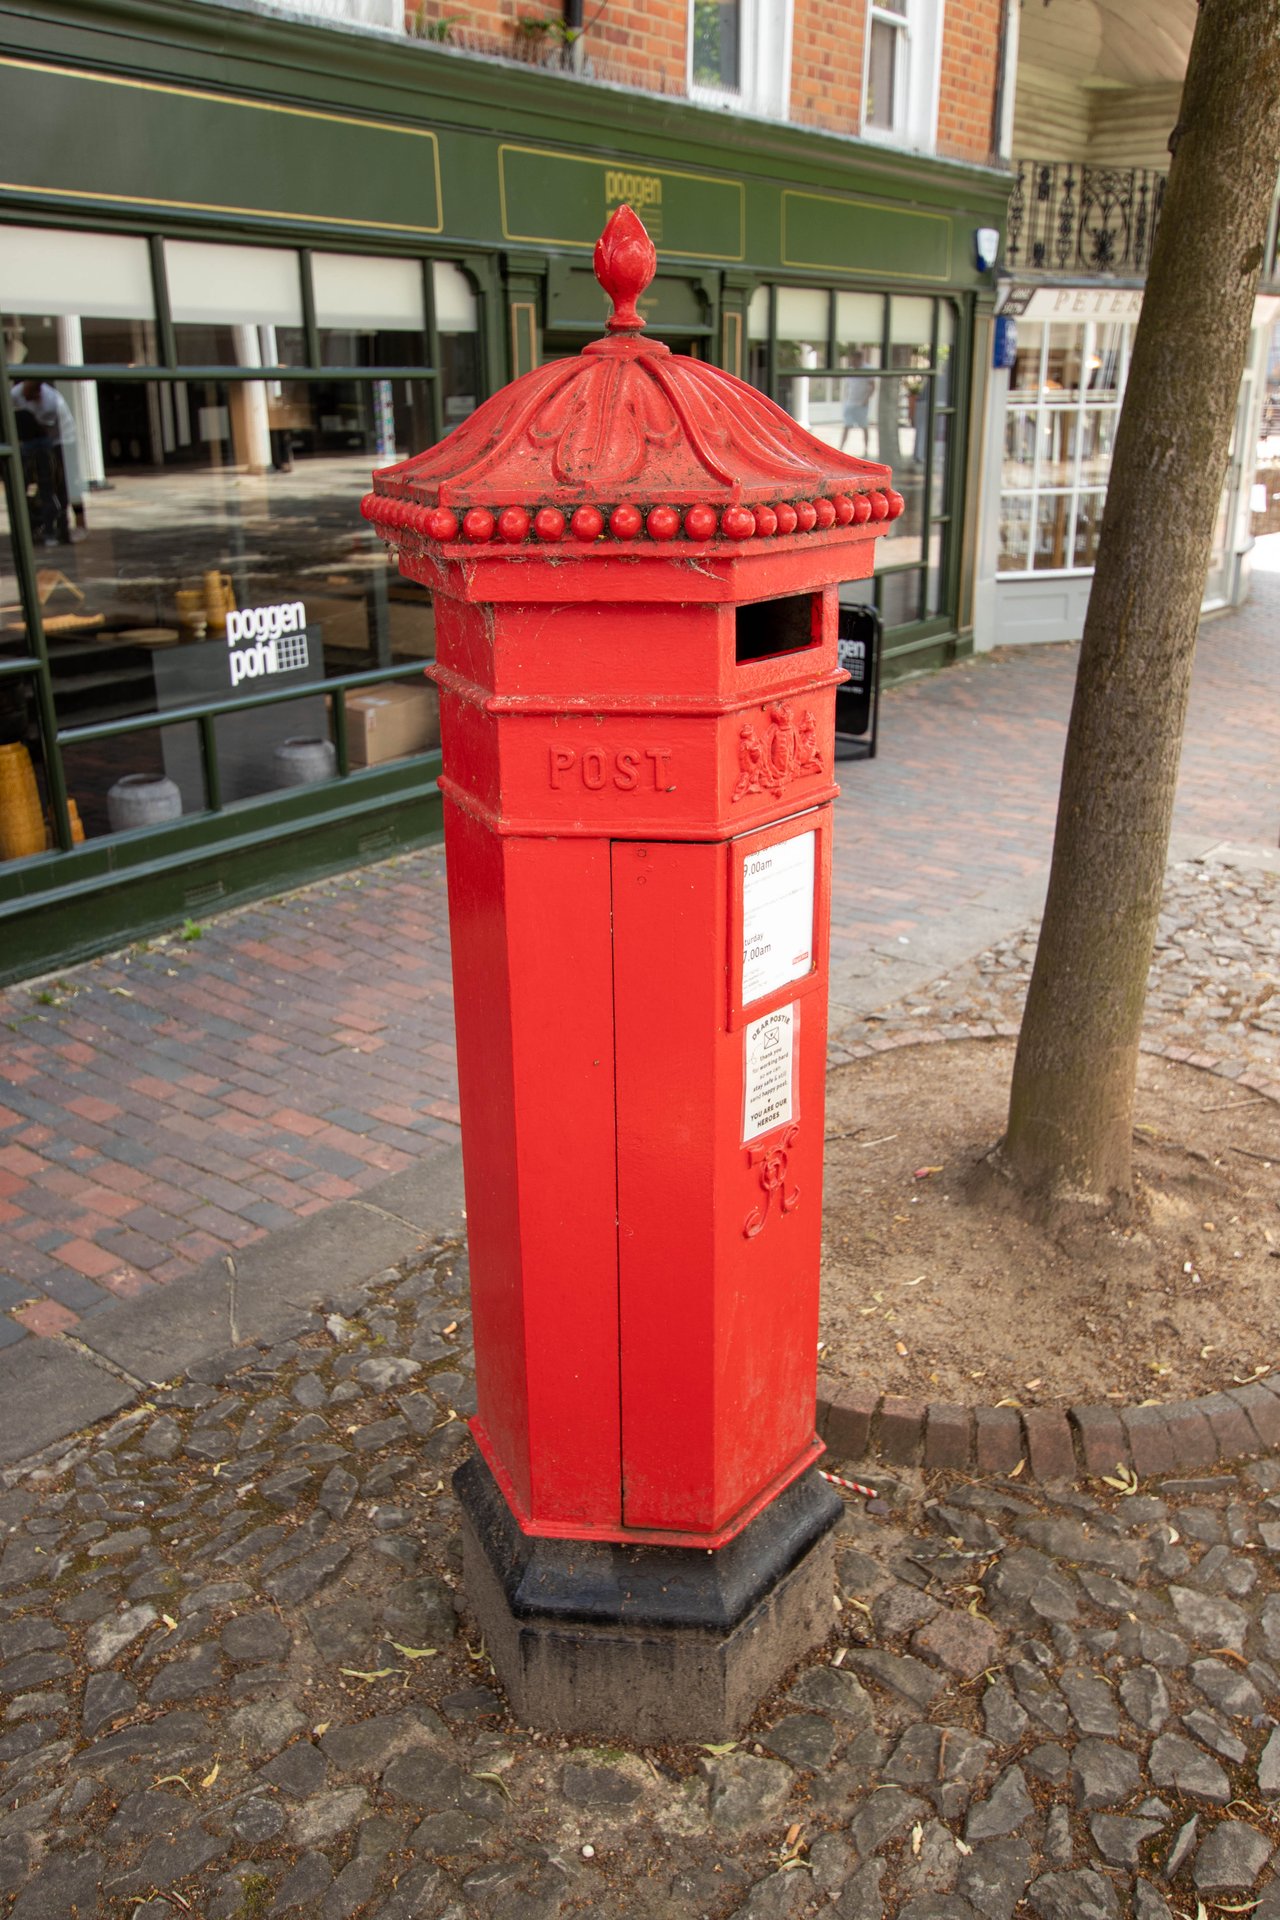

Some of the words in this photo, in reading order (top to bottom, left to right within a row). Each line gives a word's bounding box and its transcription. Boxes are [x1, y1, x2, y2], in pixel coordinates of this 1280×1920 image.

[605, 170, 662, 207] poggen
[226, 601, 306, 647] poggen
[229, 639, 279, 687] pohl
[549, 745, 672, 791] POST
[743, 859, 772, 877] 9.00am
[744, 932, 764, 946] turday
[743, 943, 772, 964] 7.00am
[752, 1019, 769, 1041] DEAR
[770, 1014, 791, 1024] POSTIE
[750, 1110, 763, 1121] YOU
[763, 1104, 774, 1115] ARE
[775, 1098, 787, 1109] OUR
[757, 1111, 780, 1128] HEROES
